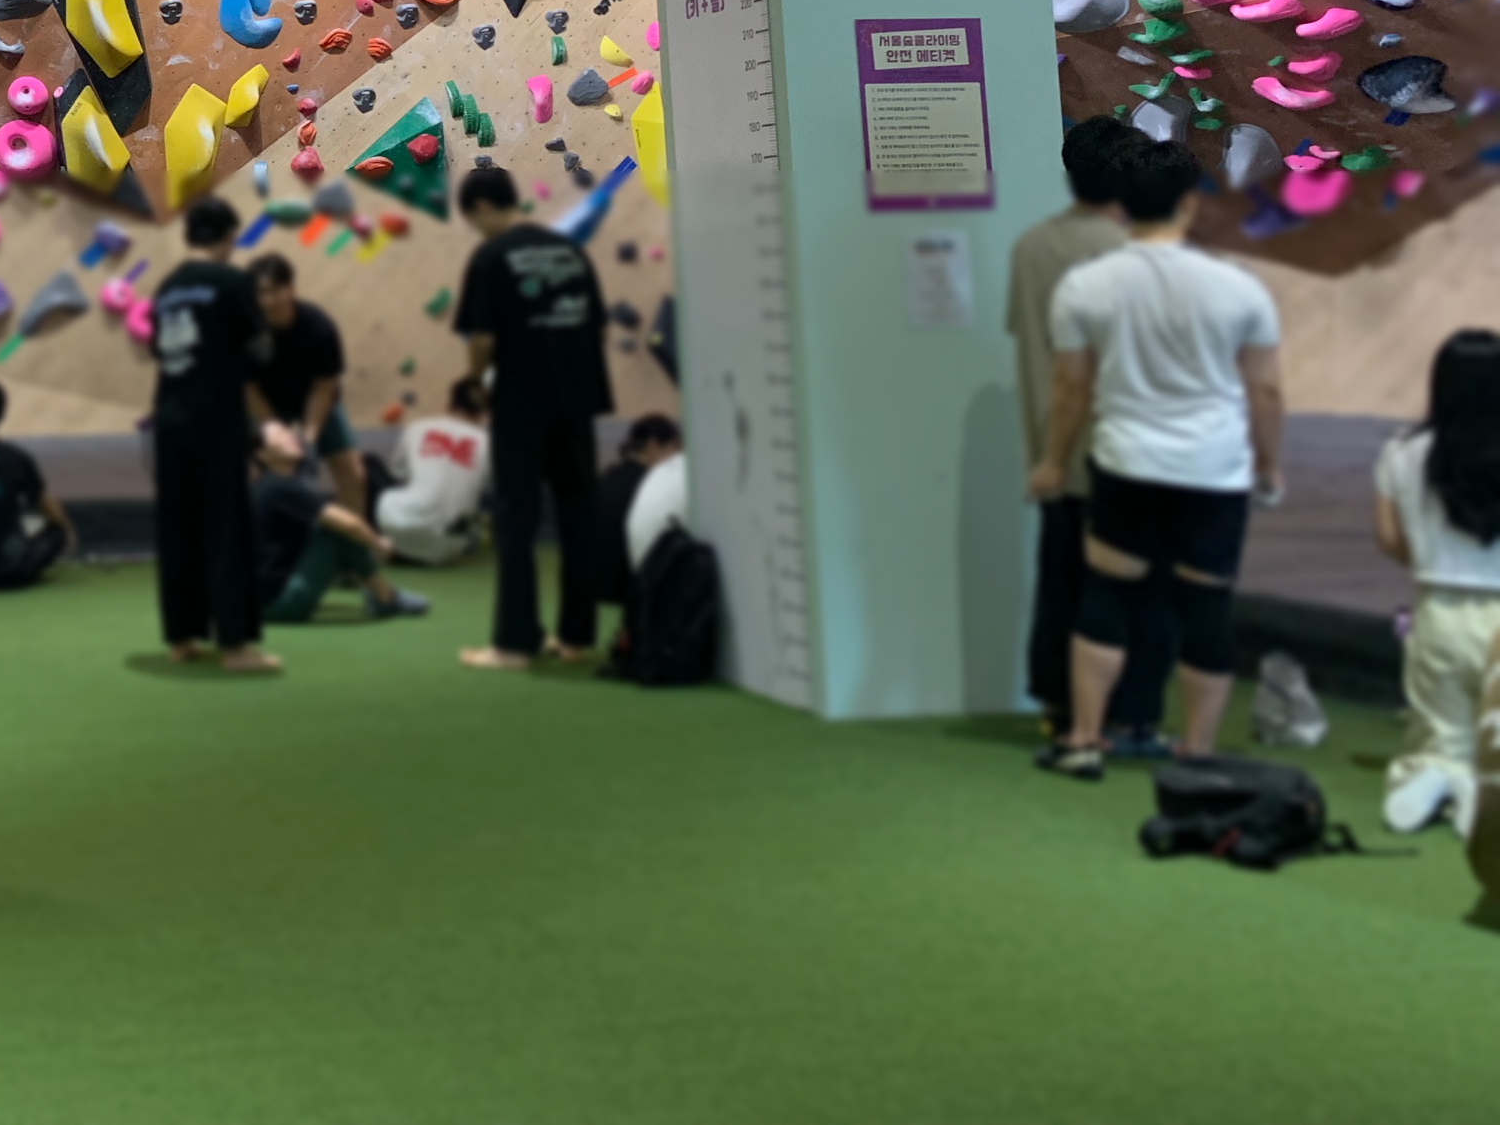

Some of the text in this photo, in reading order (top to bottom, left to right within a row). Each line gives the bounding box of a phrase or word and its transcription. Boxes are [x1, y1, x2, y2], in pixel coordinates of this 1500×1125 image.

[742, 29, 754, 40] 210
[879, 34, 960, 47] 서울숲클라이밍
[886, 49, 956, 63] 안전 에티켓
[745, 59, 757, 71] 200
[747, 90, 758, 102] 190
[749, 121, 760, 133] 180
[751, 153, 762, 165] 170
